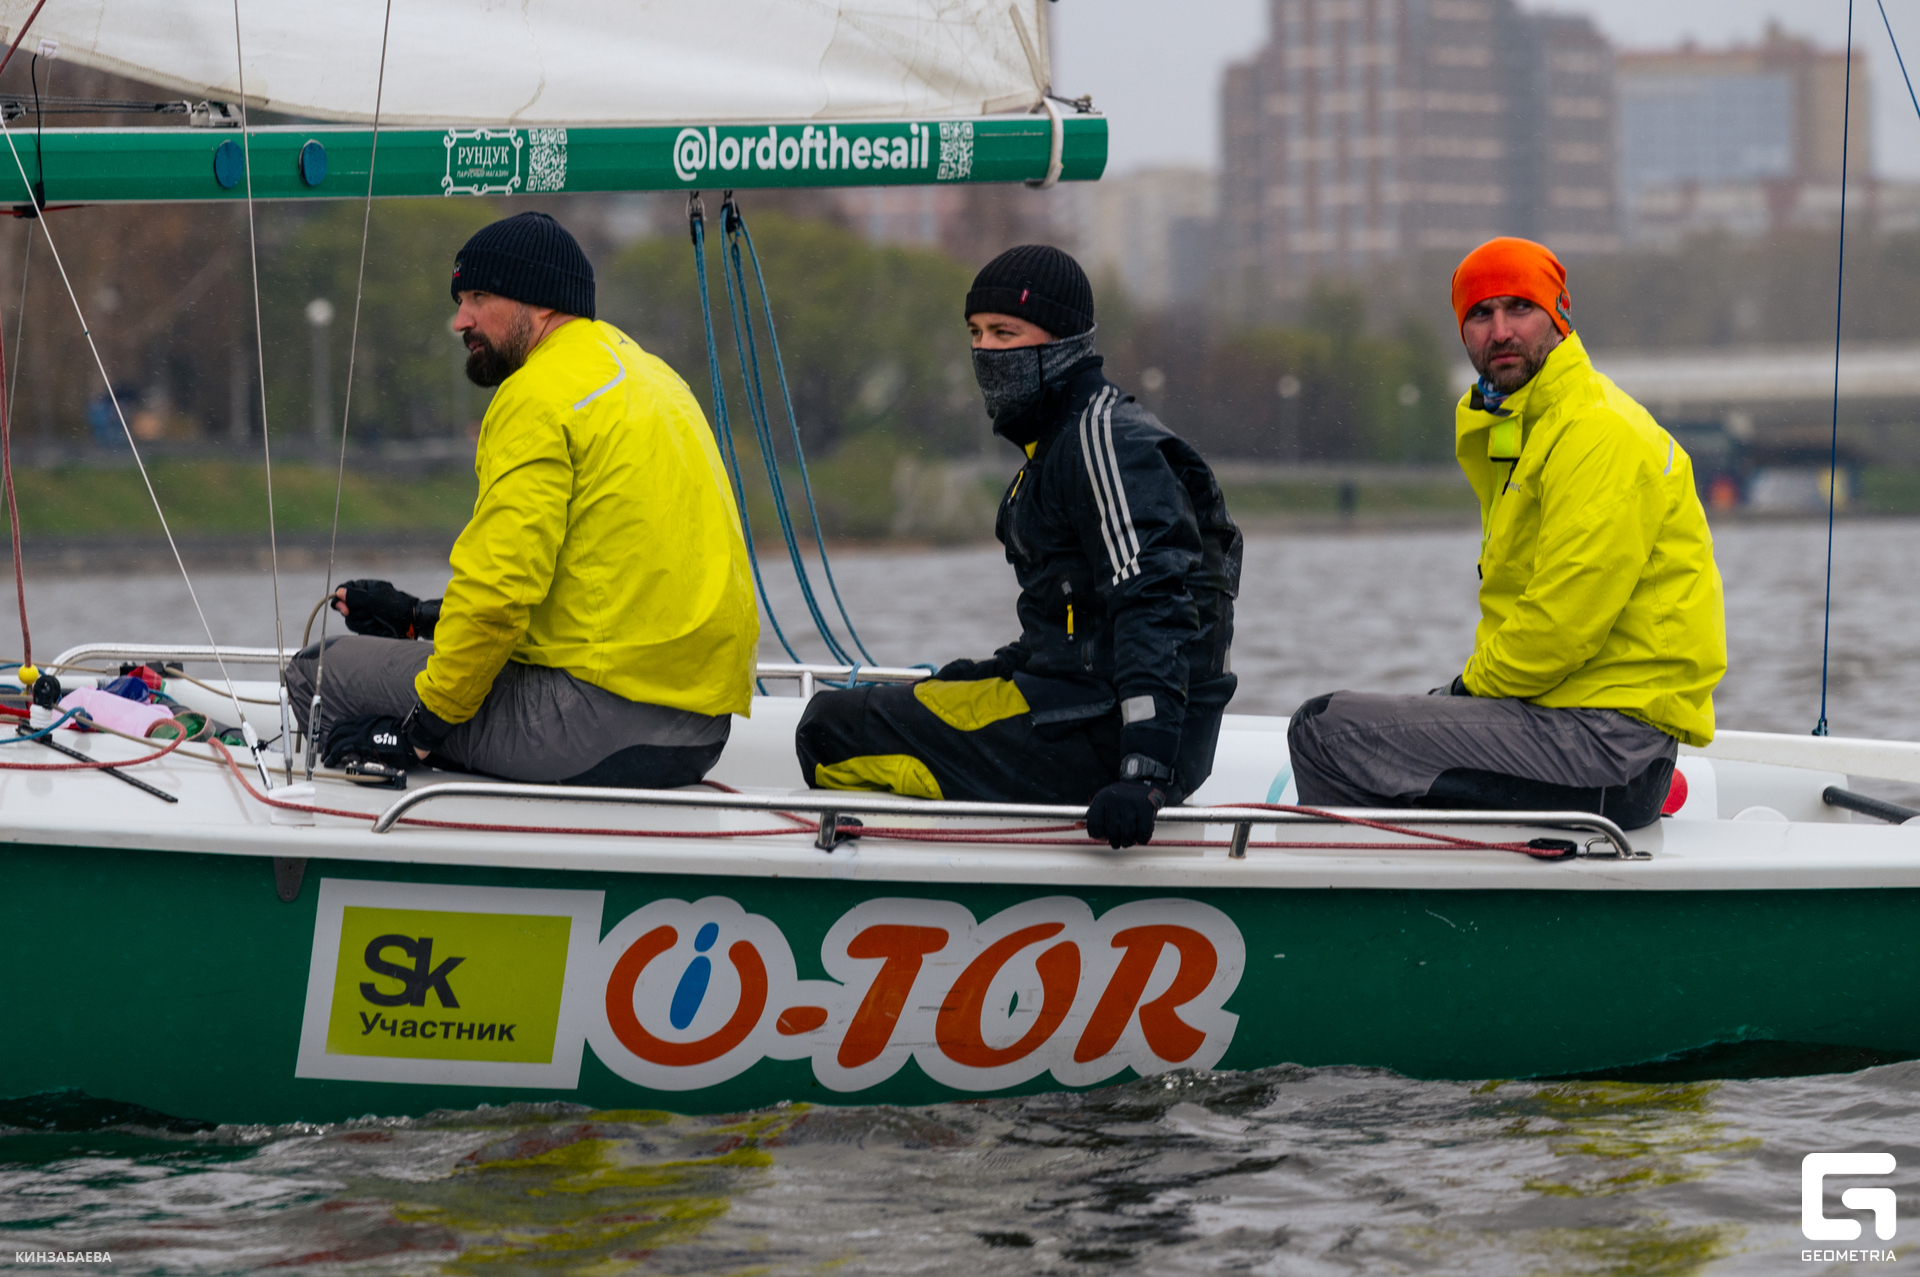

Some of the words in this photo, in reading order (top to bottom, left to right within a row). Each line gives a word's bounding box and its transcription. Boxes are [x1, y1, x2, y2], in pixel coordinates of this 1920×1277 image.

[457, 145, 510, 169] РУНДУК
[673, 122, 930, 182] @lordofthesail
[359, 933, 468, 1009] Sk
[359, 1012, 518, 1042] Участник
